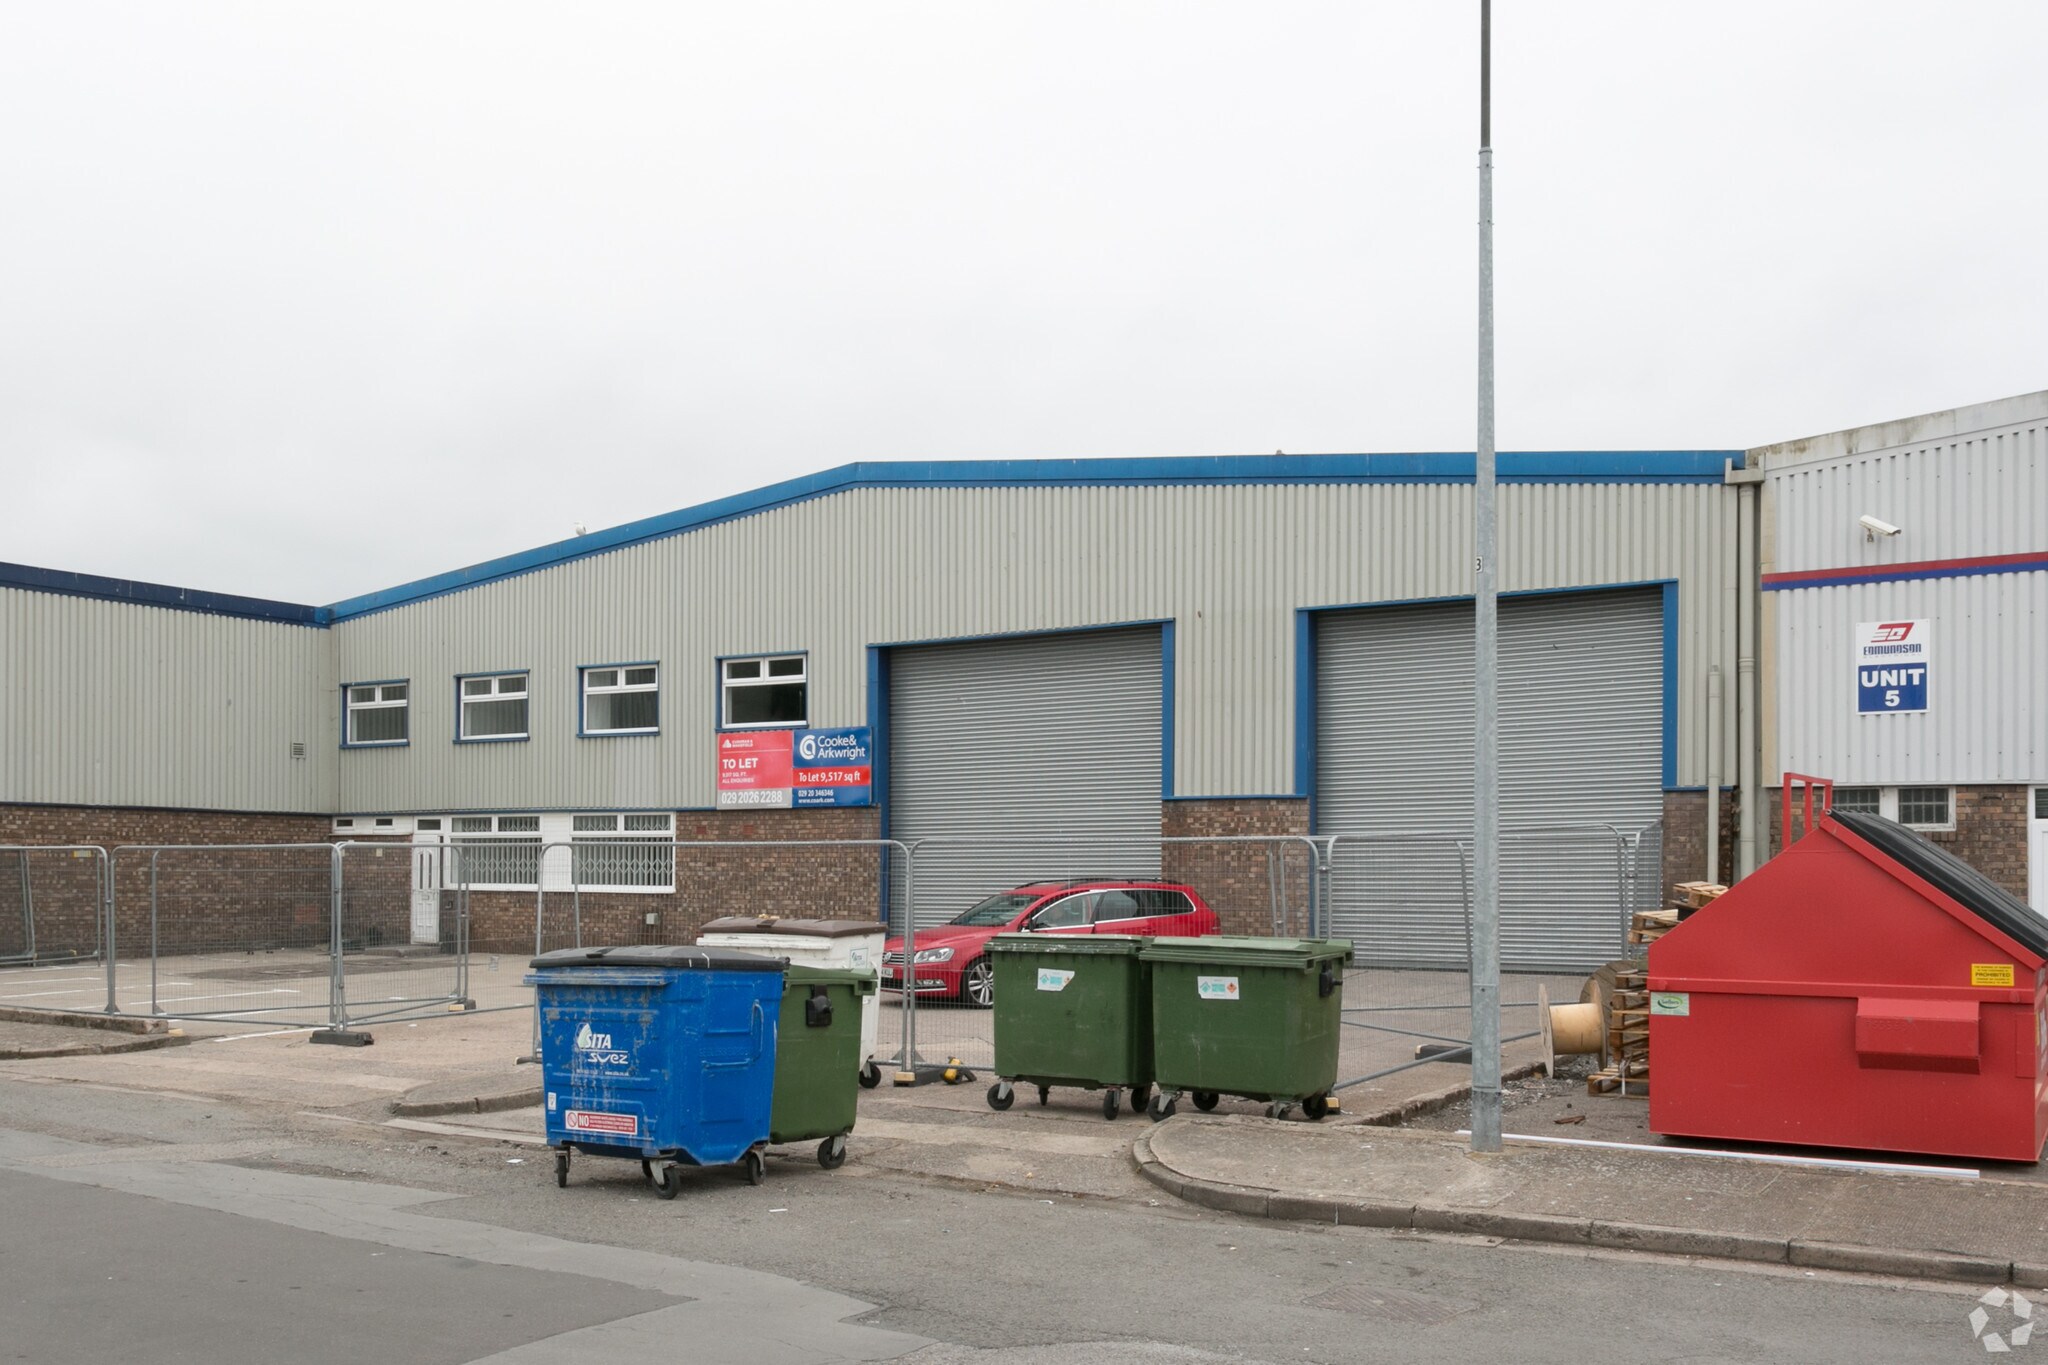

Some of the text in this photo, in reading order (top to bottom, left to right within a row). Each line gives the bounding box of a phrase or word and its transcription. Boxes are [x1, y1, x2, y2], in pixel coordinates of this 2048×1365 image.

[1863, 643, 1922, 656] EDMUNDSON
[1861, 668, 1925, 688] UNIT
[1884, 689, 1900, 707] 5
[818, 746, 866, 760] Arkwright
[722, 758, 758, 769] TO LET
[799, 771, 861, 783] To Let 9,517 sq ft
[721, 790, 783, 804] 029 2026 2288
[585, 1033, 611, 1049] SITA
[579, 1114, 589, 1127] NO
